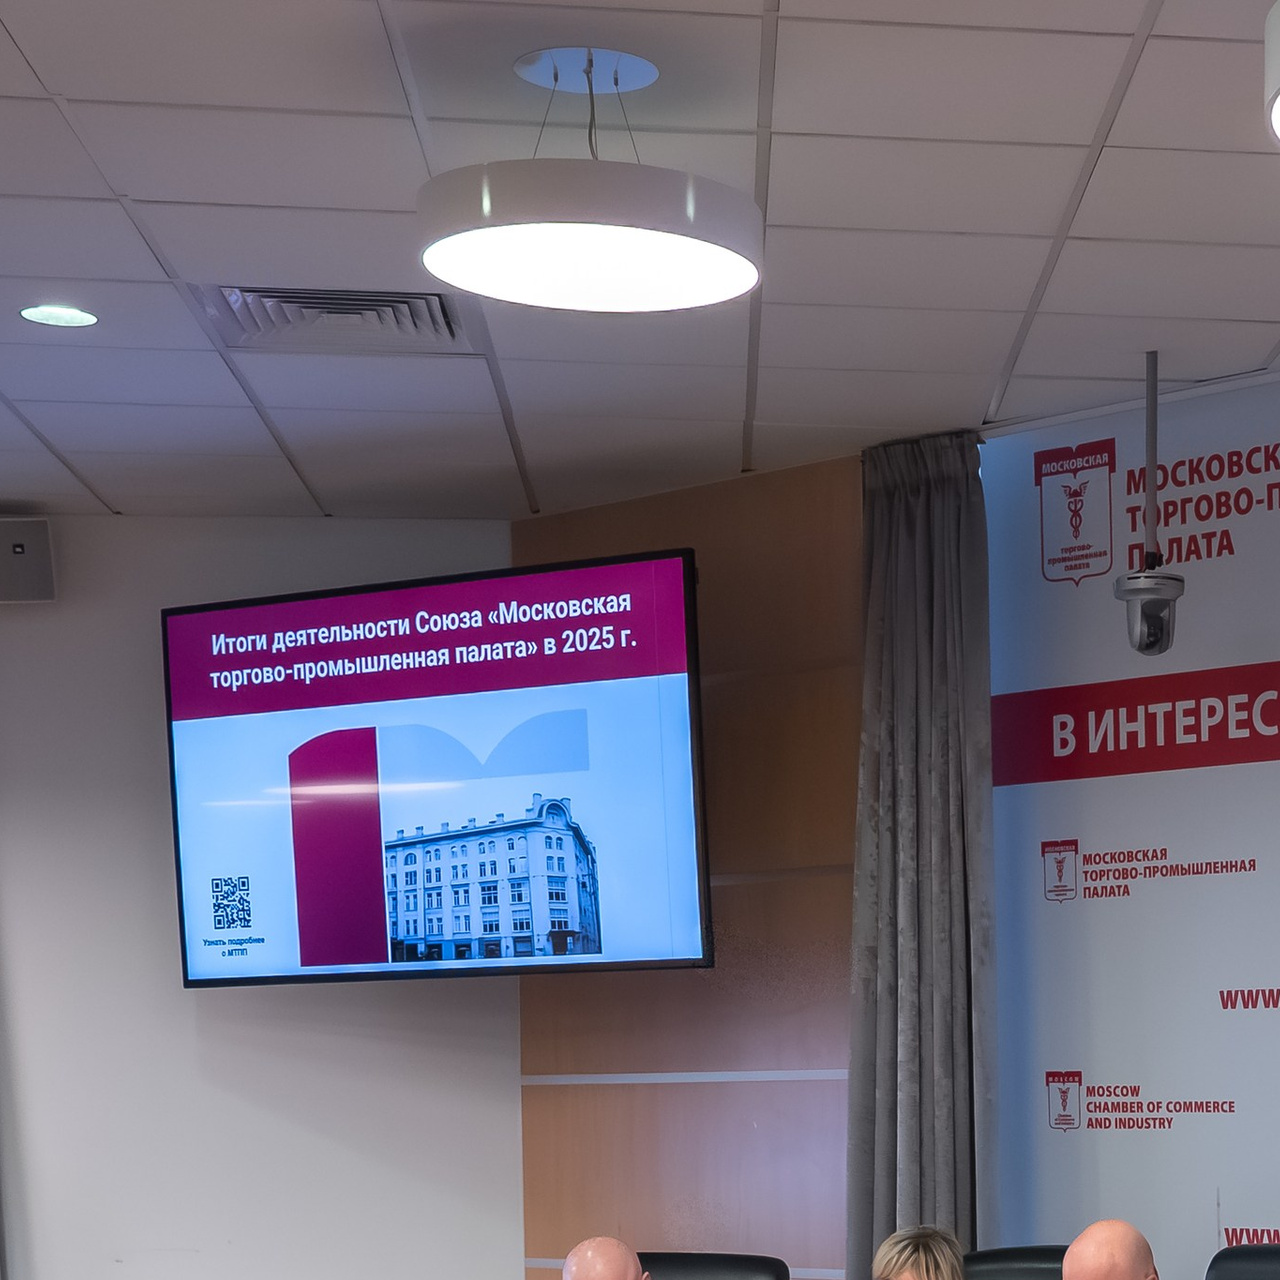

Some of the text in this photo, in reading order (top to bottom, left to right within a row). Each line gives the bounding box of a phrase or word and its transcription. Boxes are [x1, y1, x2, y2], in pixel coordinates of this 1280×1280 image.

[1041, 453, 1109, 474] МОСКОВСКАЯ
[1127, 529, 1236, 571] ПЛАТА
[211, 593, 632, 656] Итоги деятельности Союза «Московская
[209, 625, 637, 692] торгово-промышленная палата» в 2025 г.
[1052, 714, 1076, 758] В
[1082, 848, 1168, 866] МОСКОВСКАЯ
[1082, 859, 1257, 883] ТОРГОВО-ПРОМЫШЛЕННАЯ
[1083, 884, 1130, 899] ПАЛАТА
[1086, 1085, 1141, 1098] MOSCOW
[1086, 1101, 1236, 1113] CHAMBER OF COMMERCE
[1086, 1117, 1112, 1129] AND
[1115, 1117, 1174, 1129] INDUSTRY
